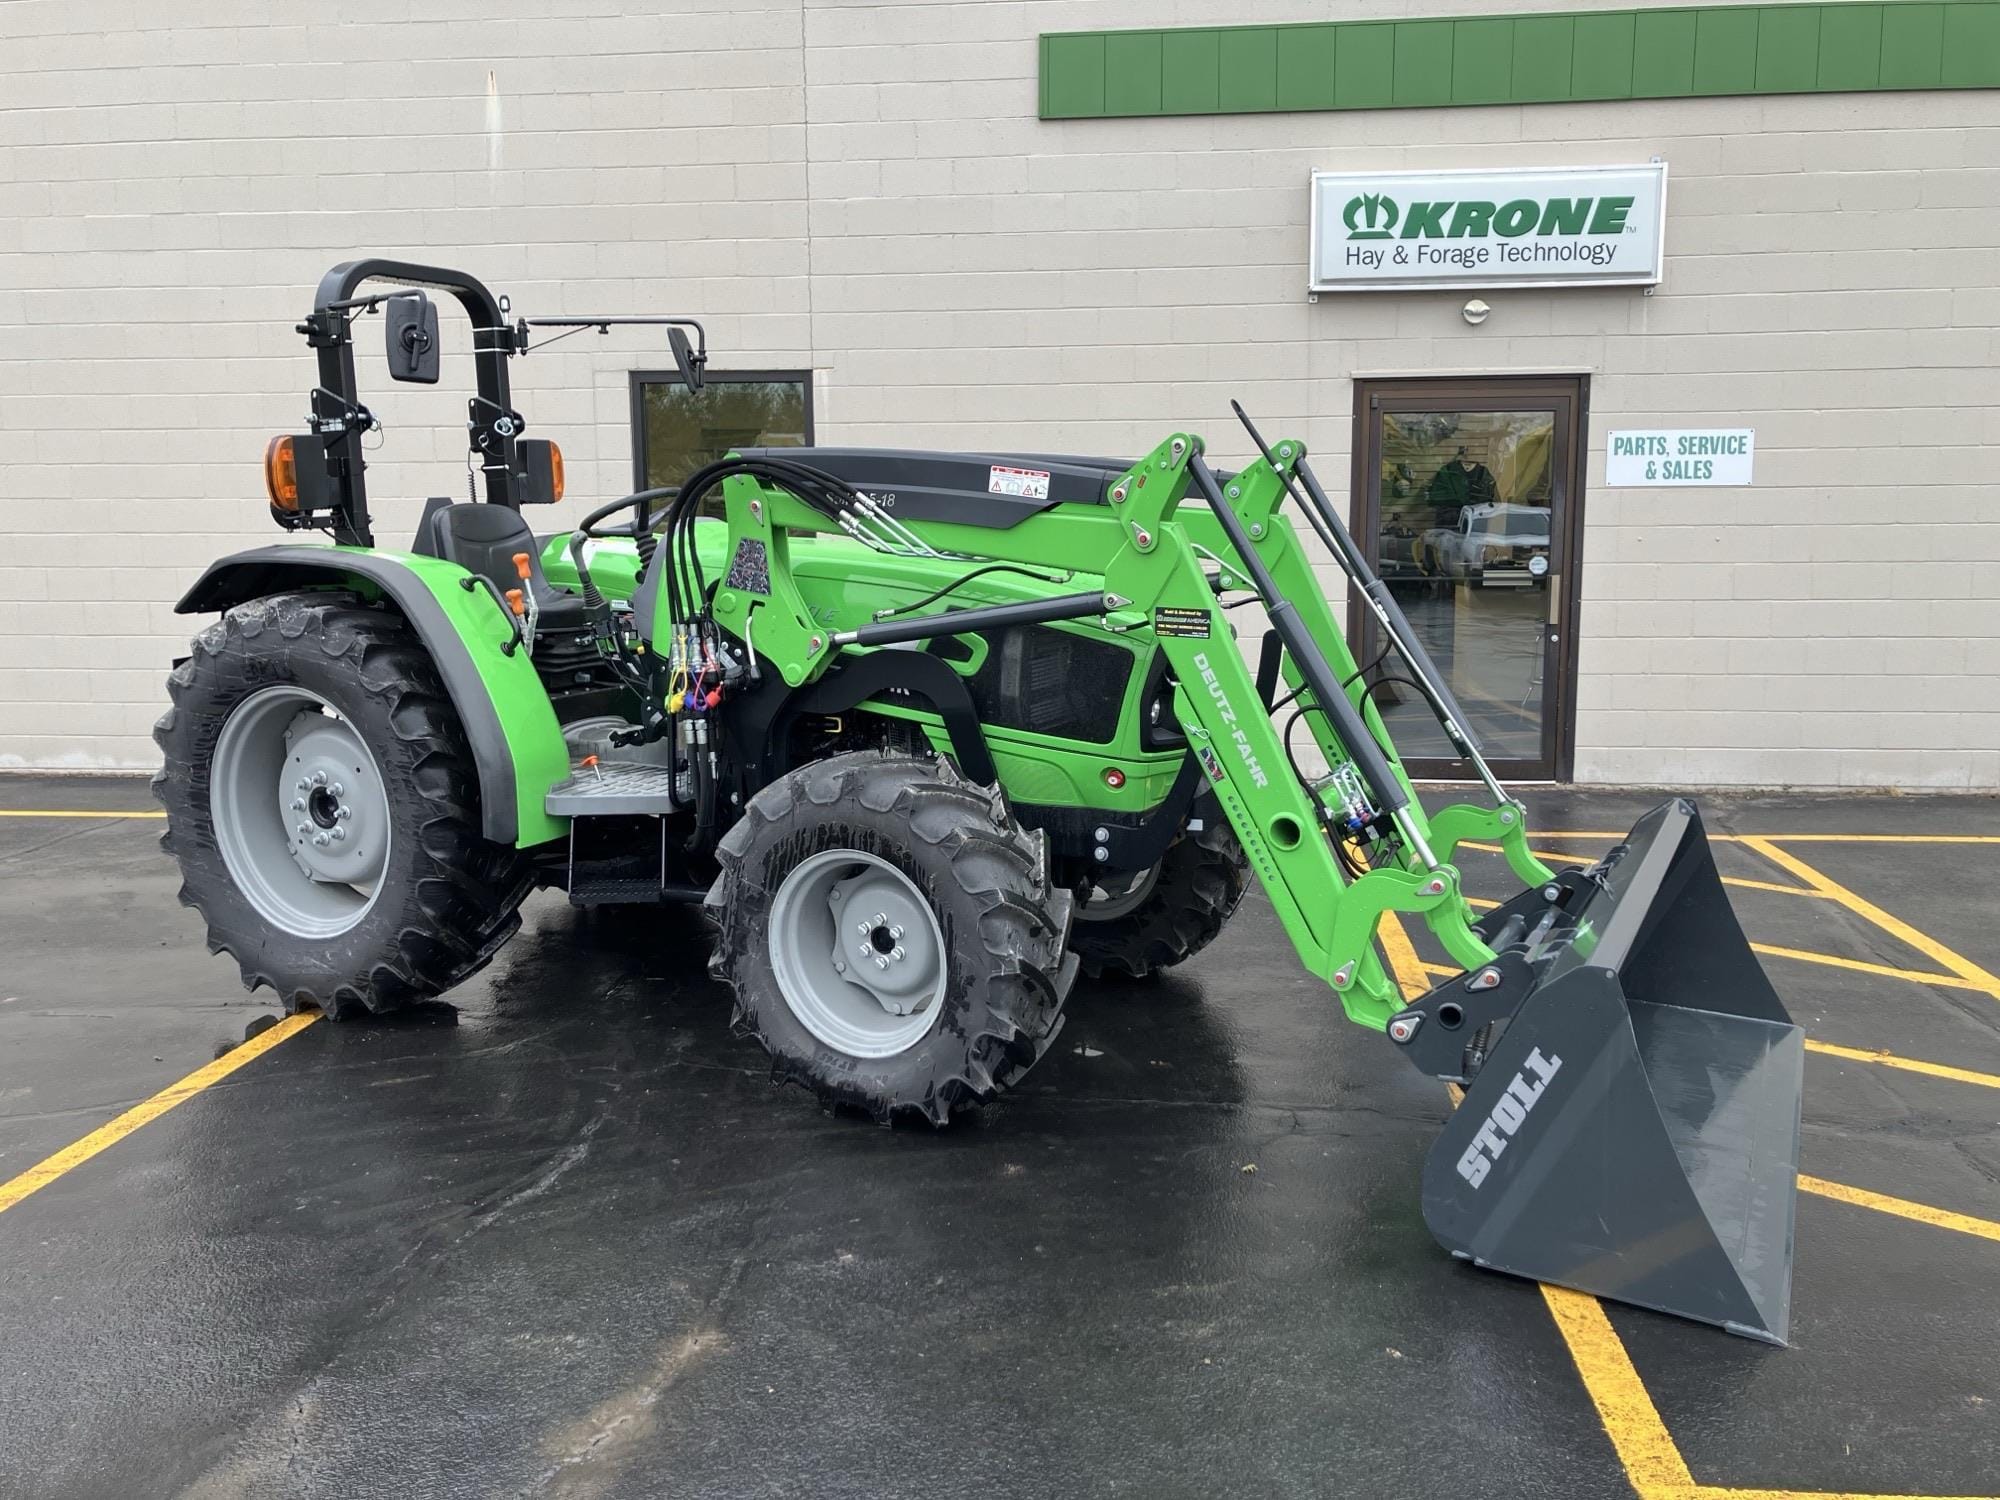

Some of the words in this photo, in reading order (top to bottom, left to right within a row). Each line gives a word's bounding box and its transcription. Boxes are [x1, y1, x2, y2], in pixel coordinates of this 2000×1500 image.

[1400, 196, 1635, 239] KRONE
[1346, 246, 1385, 269] Hay
[1393, 245, 1409, 264] &
[1418, 245, 1489, 268] Forage
[1497, 241, 1617, 265] Technology
[1614, 436, 1670, 457] PARTS,
[1678, 435, 1748, 455] SERVICE
[1645, 460, 1657, 480] &
[1662, 460, 1713, 480] SALES
[1193, 652, 1269, 789] DEUTZ-FAHR
[1456, 1045, 1563, 1190] STOLL
